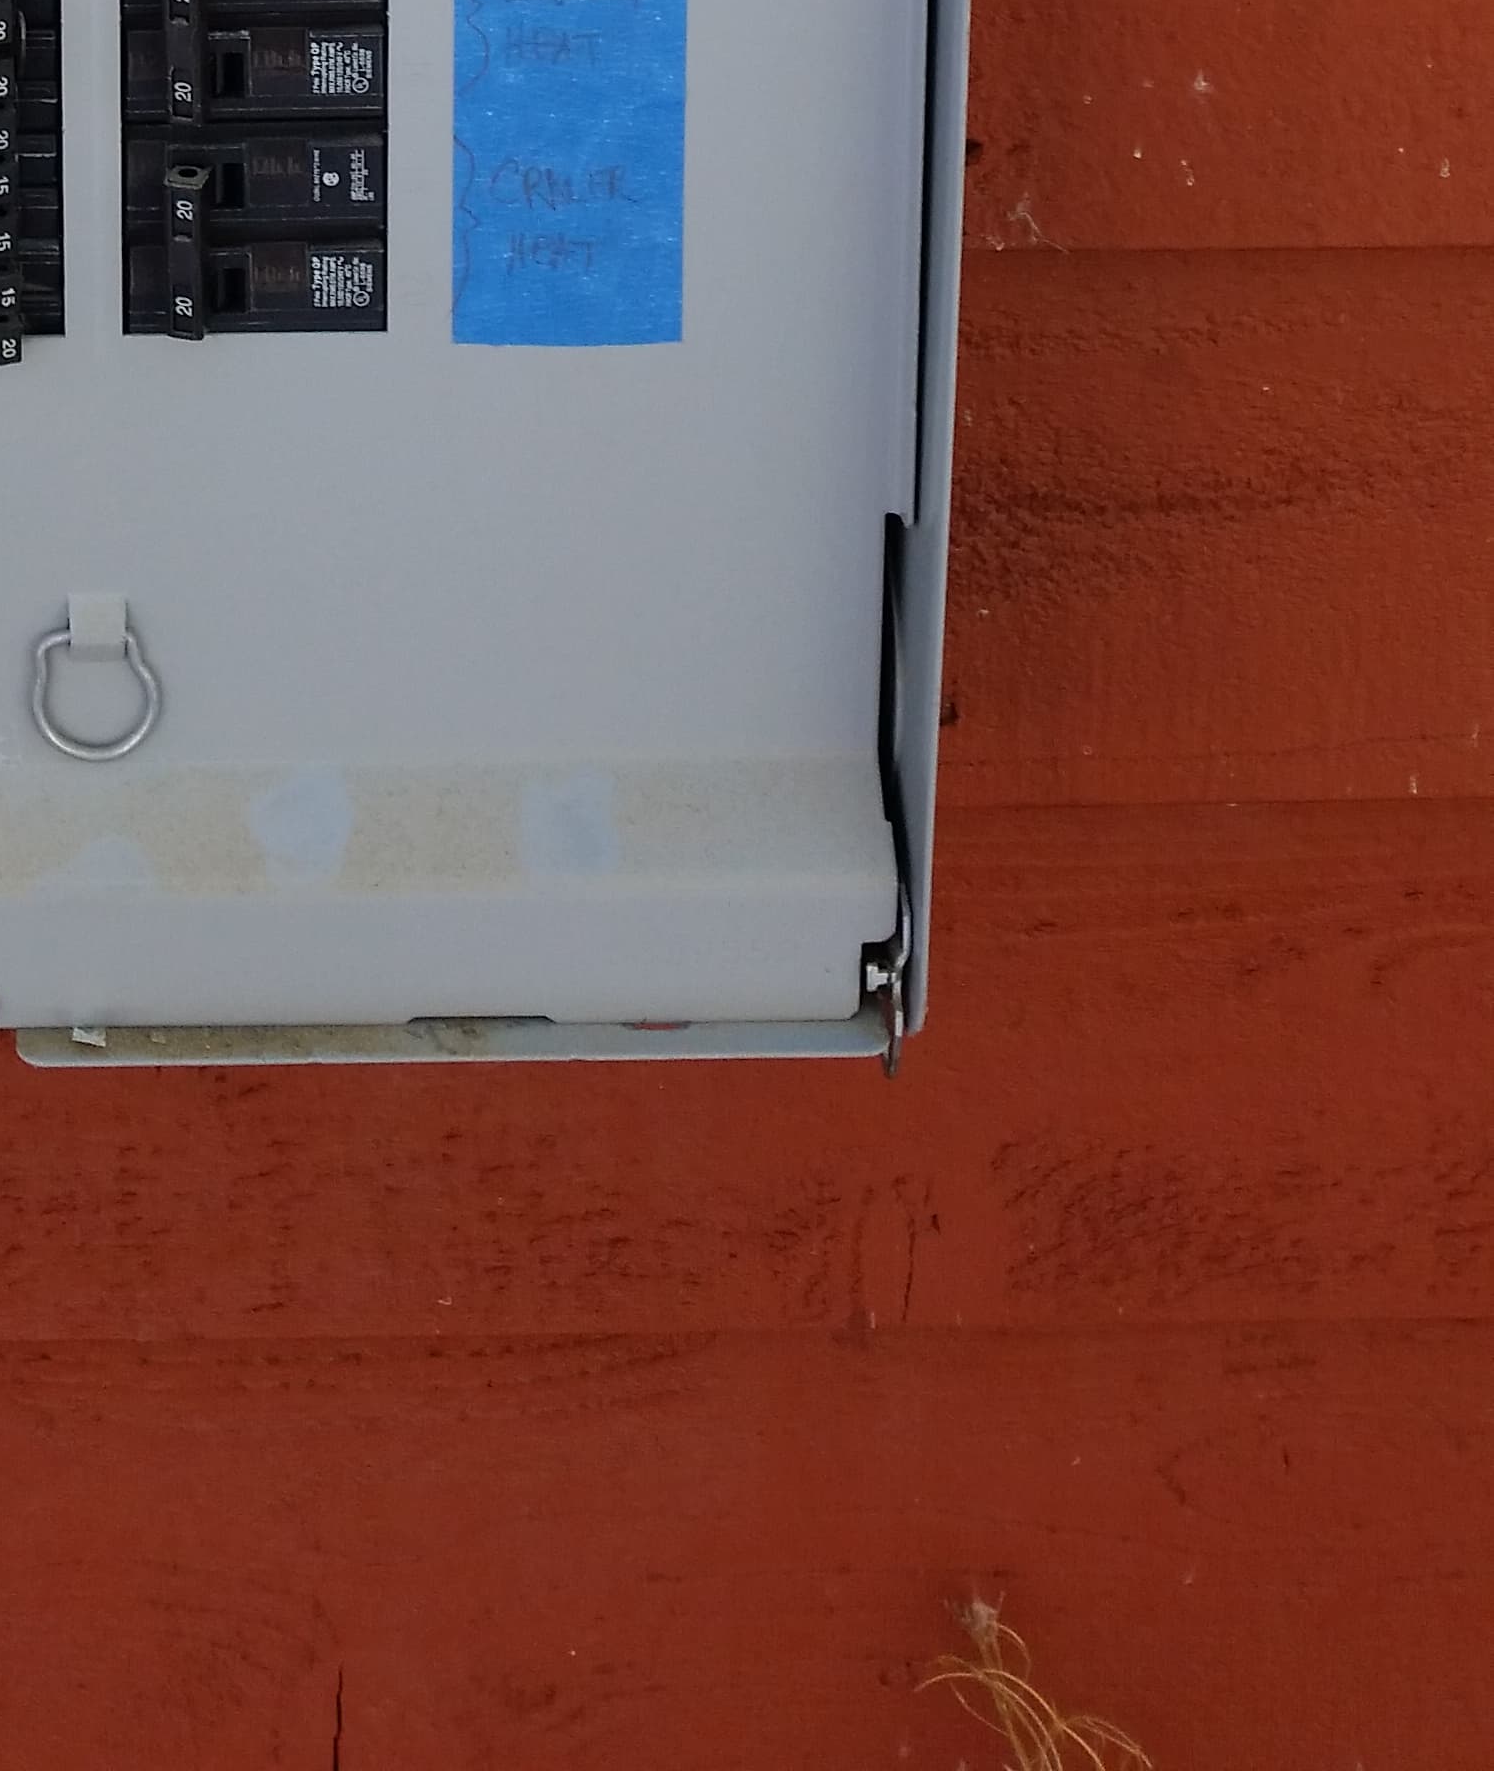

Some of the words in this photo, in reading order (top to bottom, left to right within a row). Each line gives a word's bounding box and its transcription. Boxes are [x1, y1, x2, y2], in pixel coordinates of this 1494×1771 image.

[310, 55, 322, 76] Type
[175, 81, 192, 102] 20
[177, 200, 194, 222] 20
[311, 269, 323, 290] Type
[1, 287, 16, 308] 15
[176, 295, 194, 317] 20
[2, 338, 17, 359] 20
